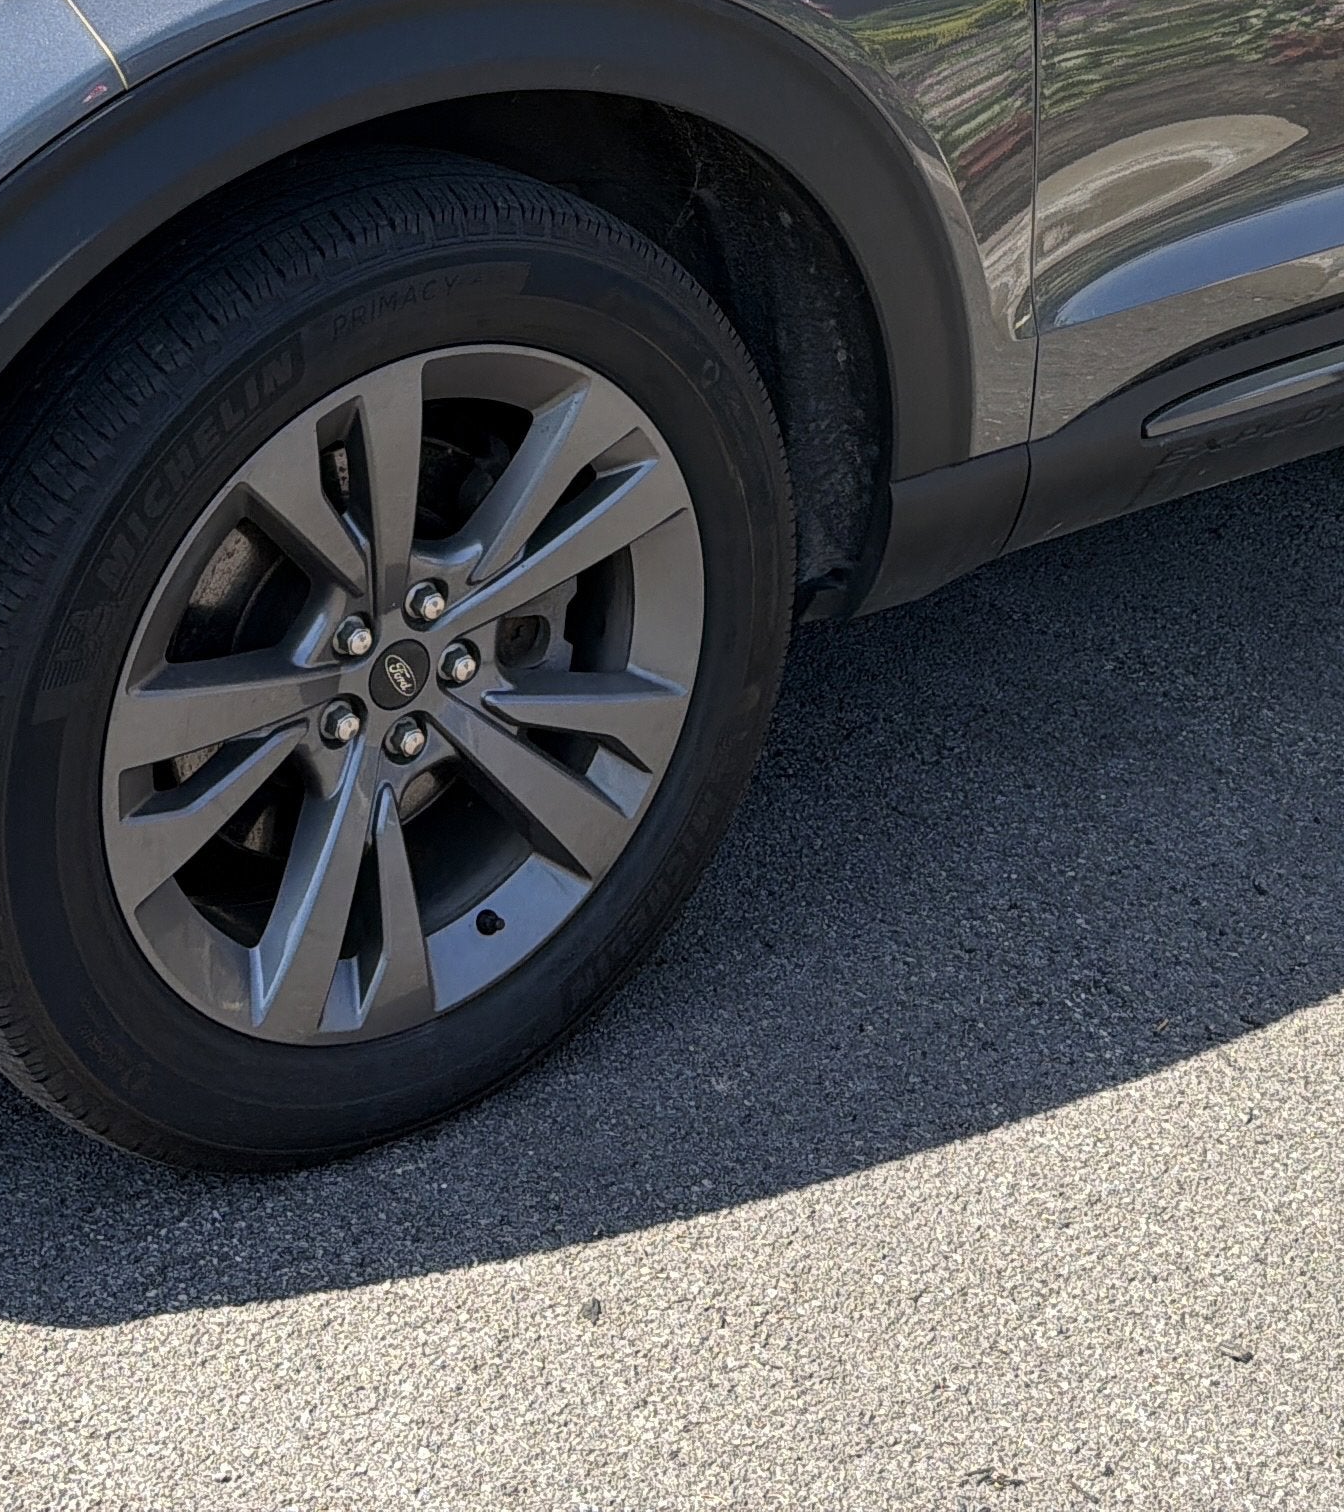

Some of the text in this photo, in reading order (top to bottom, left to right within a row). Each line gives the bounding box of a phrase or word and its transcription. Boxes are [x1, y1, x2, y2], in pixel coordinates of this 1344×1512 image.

[332, 273, 460, 337] PRIMACY
[96, 350, 294, 592] MICHELIN
[388, 662, 413, 691] Ford
